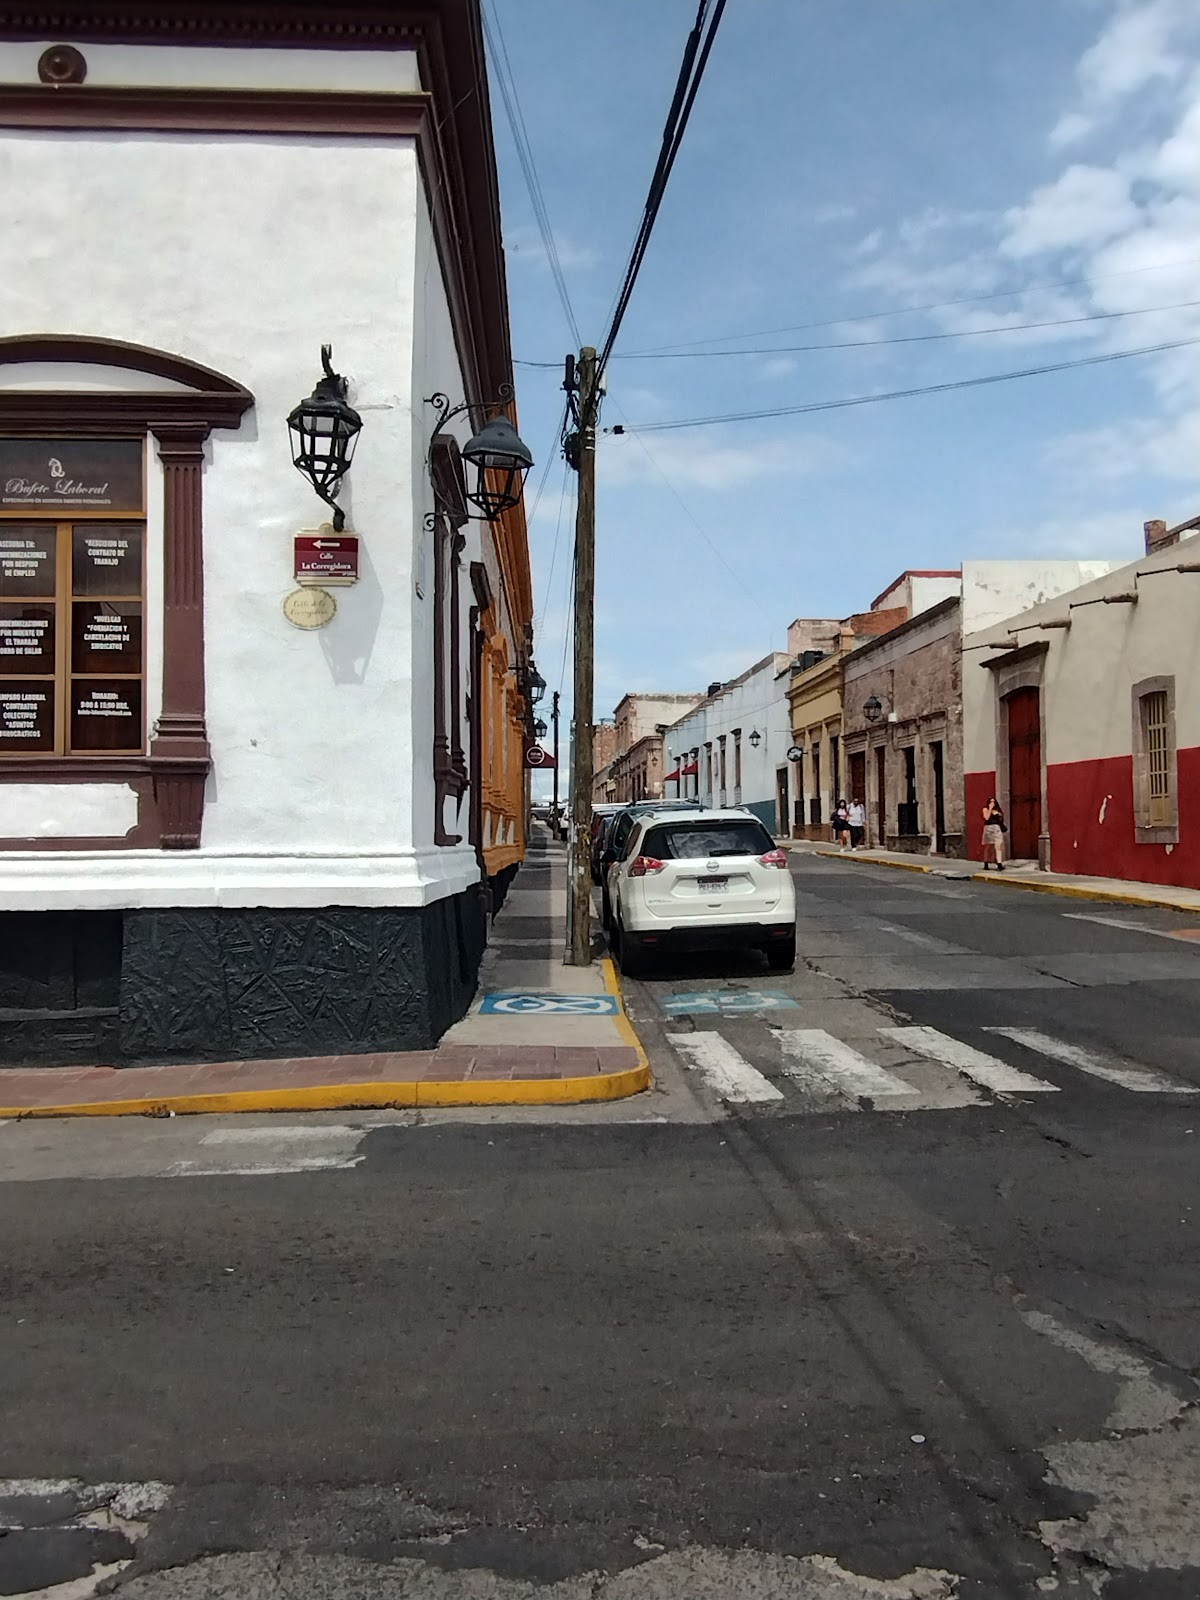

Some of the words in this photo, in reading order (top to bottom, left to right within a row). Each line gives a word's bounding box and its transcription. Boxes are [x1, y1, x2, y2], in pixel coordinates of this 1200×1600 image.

[5, 478, 49, 496] Bufete
[54, 479, 108, 495] Laboral
[88, 549, 116, 557] CONTRATO
[2, 560, 14, 568] POR
[94, 558, 118, 566] TRABAJO
[311, 562, 351, 570] Corregidora
[5, 569, 12, 577] DE
[13, 569, 36, 577] EMPLEO
[36, 629, 44, 637] EN
[94, 701, 99, 709] A
